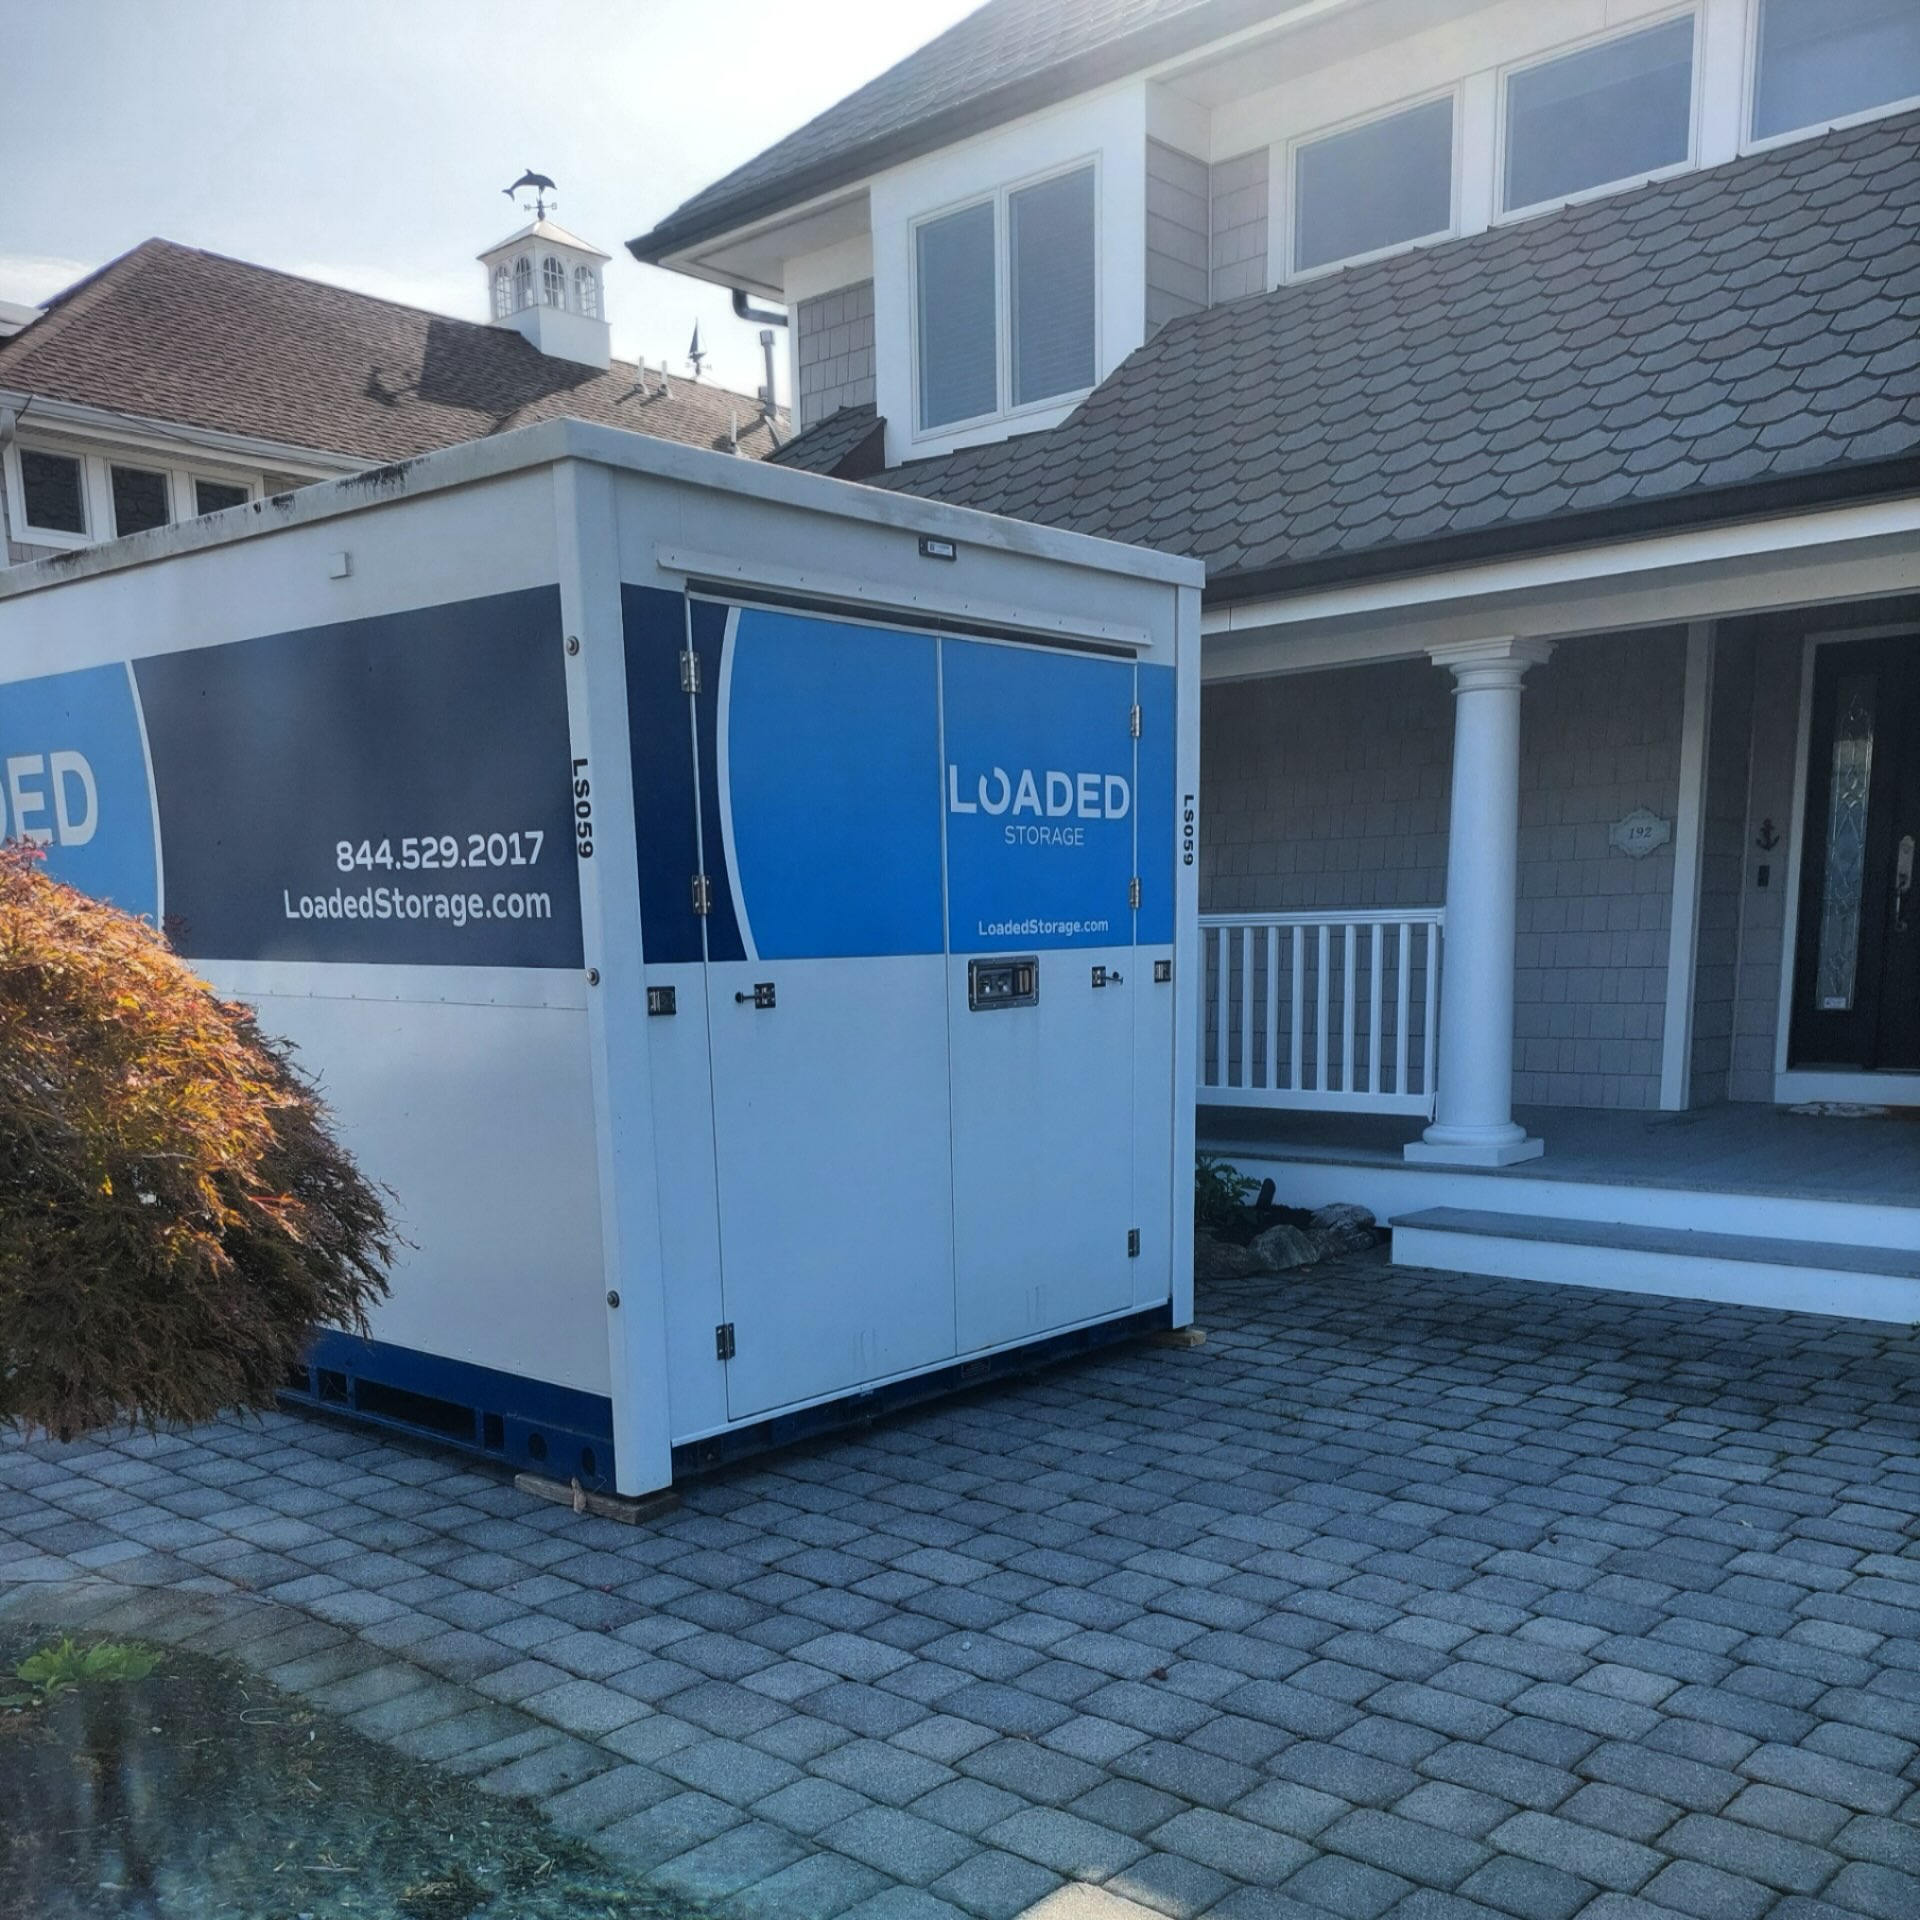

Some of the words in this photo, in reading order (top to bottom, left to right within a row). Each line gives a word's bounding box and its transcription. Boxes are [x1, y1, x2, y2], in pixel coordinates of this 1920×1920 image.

[0, 751, 98, 847] ED
[573, 758, 594, 859] LS059
[950, 765, 1130, 819] LOADED
[336, 830, 544, 872] 844.529.2017
[1005, 825, 1085, 846] STORAGE
[1183, 794, 1194, 866] LS059
[1629, 826, 1653, 840] 192
[284, 888, 551, 927] LoadedStorage.com
[979, 920, 1109, 937] LoadedStorage.com
